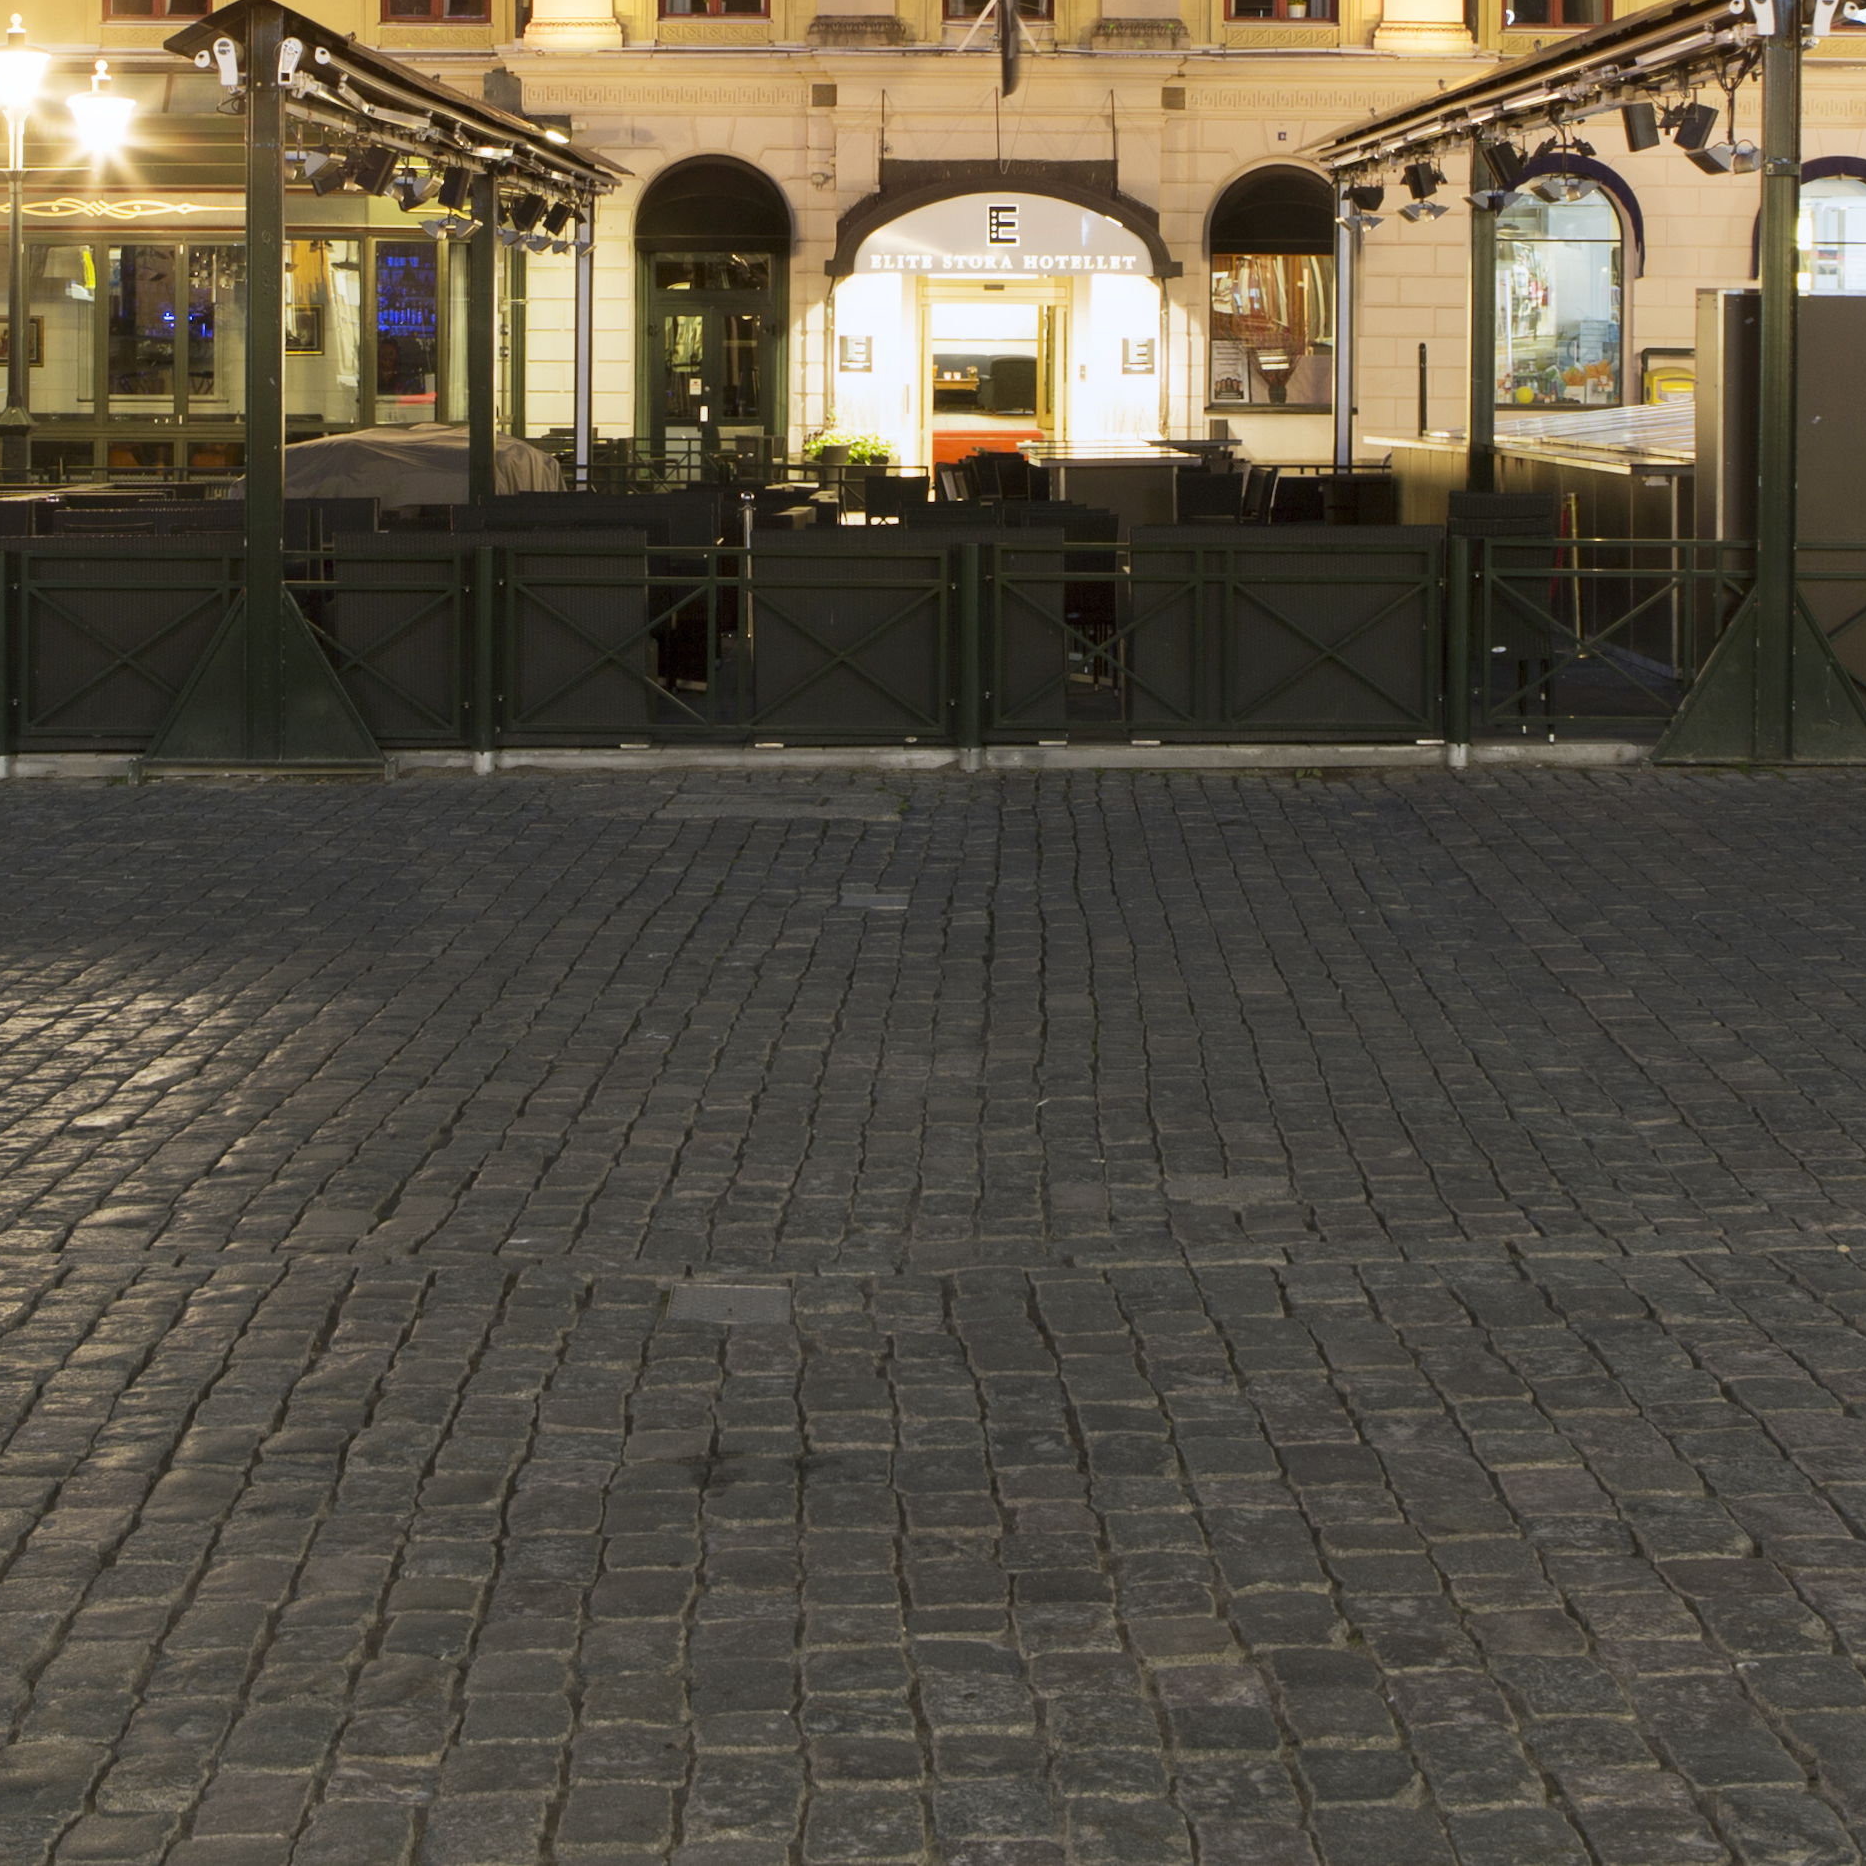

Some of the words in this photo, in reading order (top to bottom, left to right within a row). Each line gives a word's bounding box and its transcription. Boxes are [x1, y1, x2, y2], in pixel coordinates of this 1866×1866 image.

[987, 203, 1020, 247] E
[870, 254, 933, 270] ELITE
[942, 254, 1013, 270] STORA
[1023, 255, 1137, 270] HOTELLET
